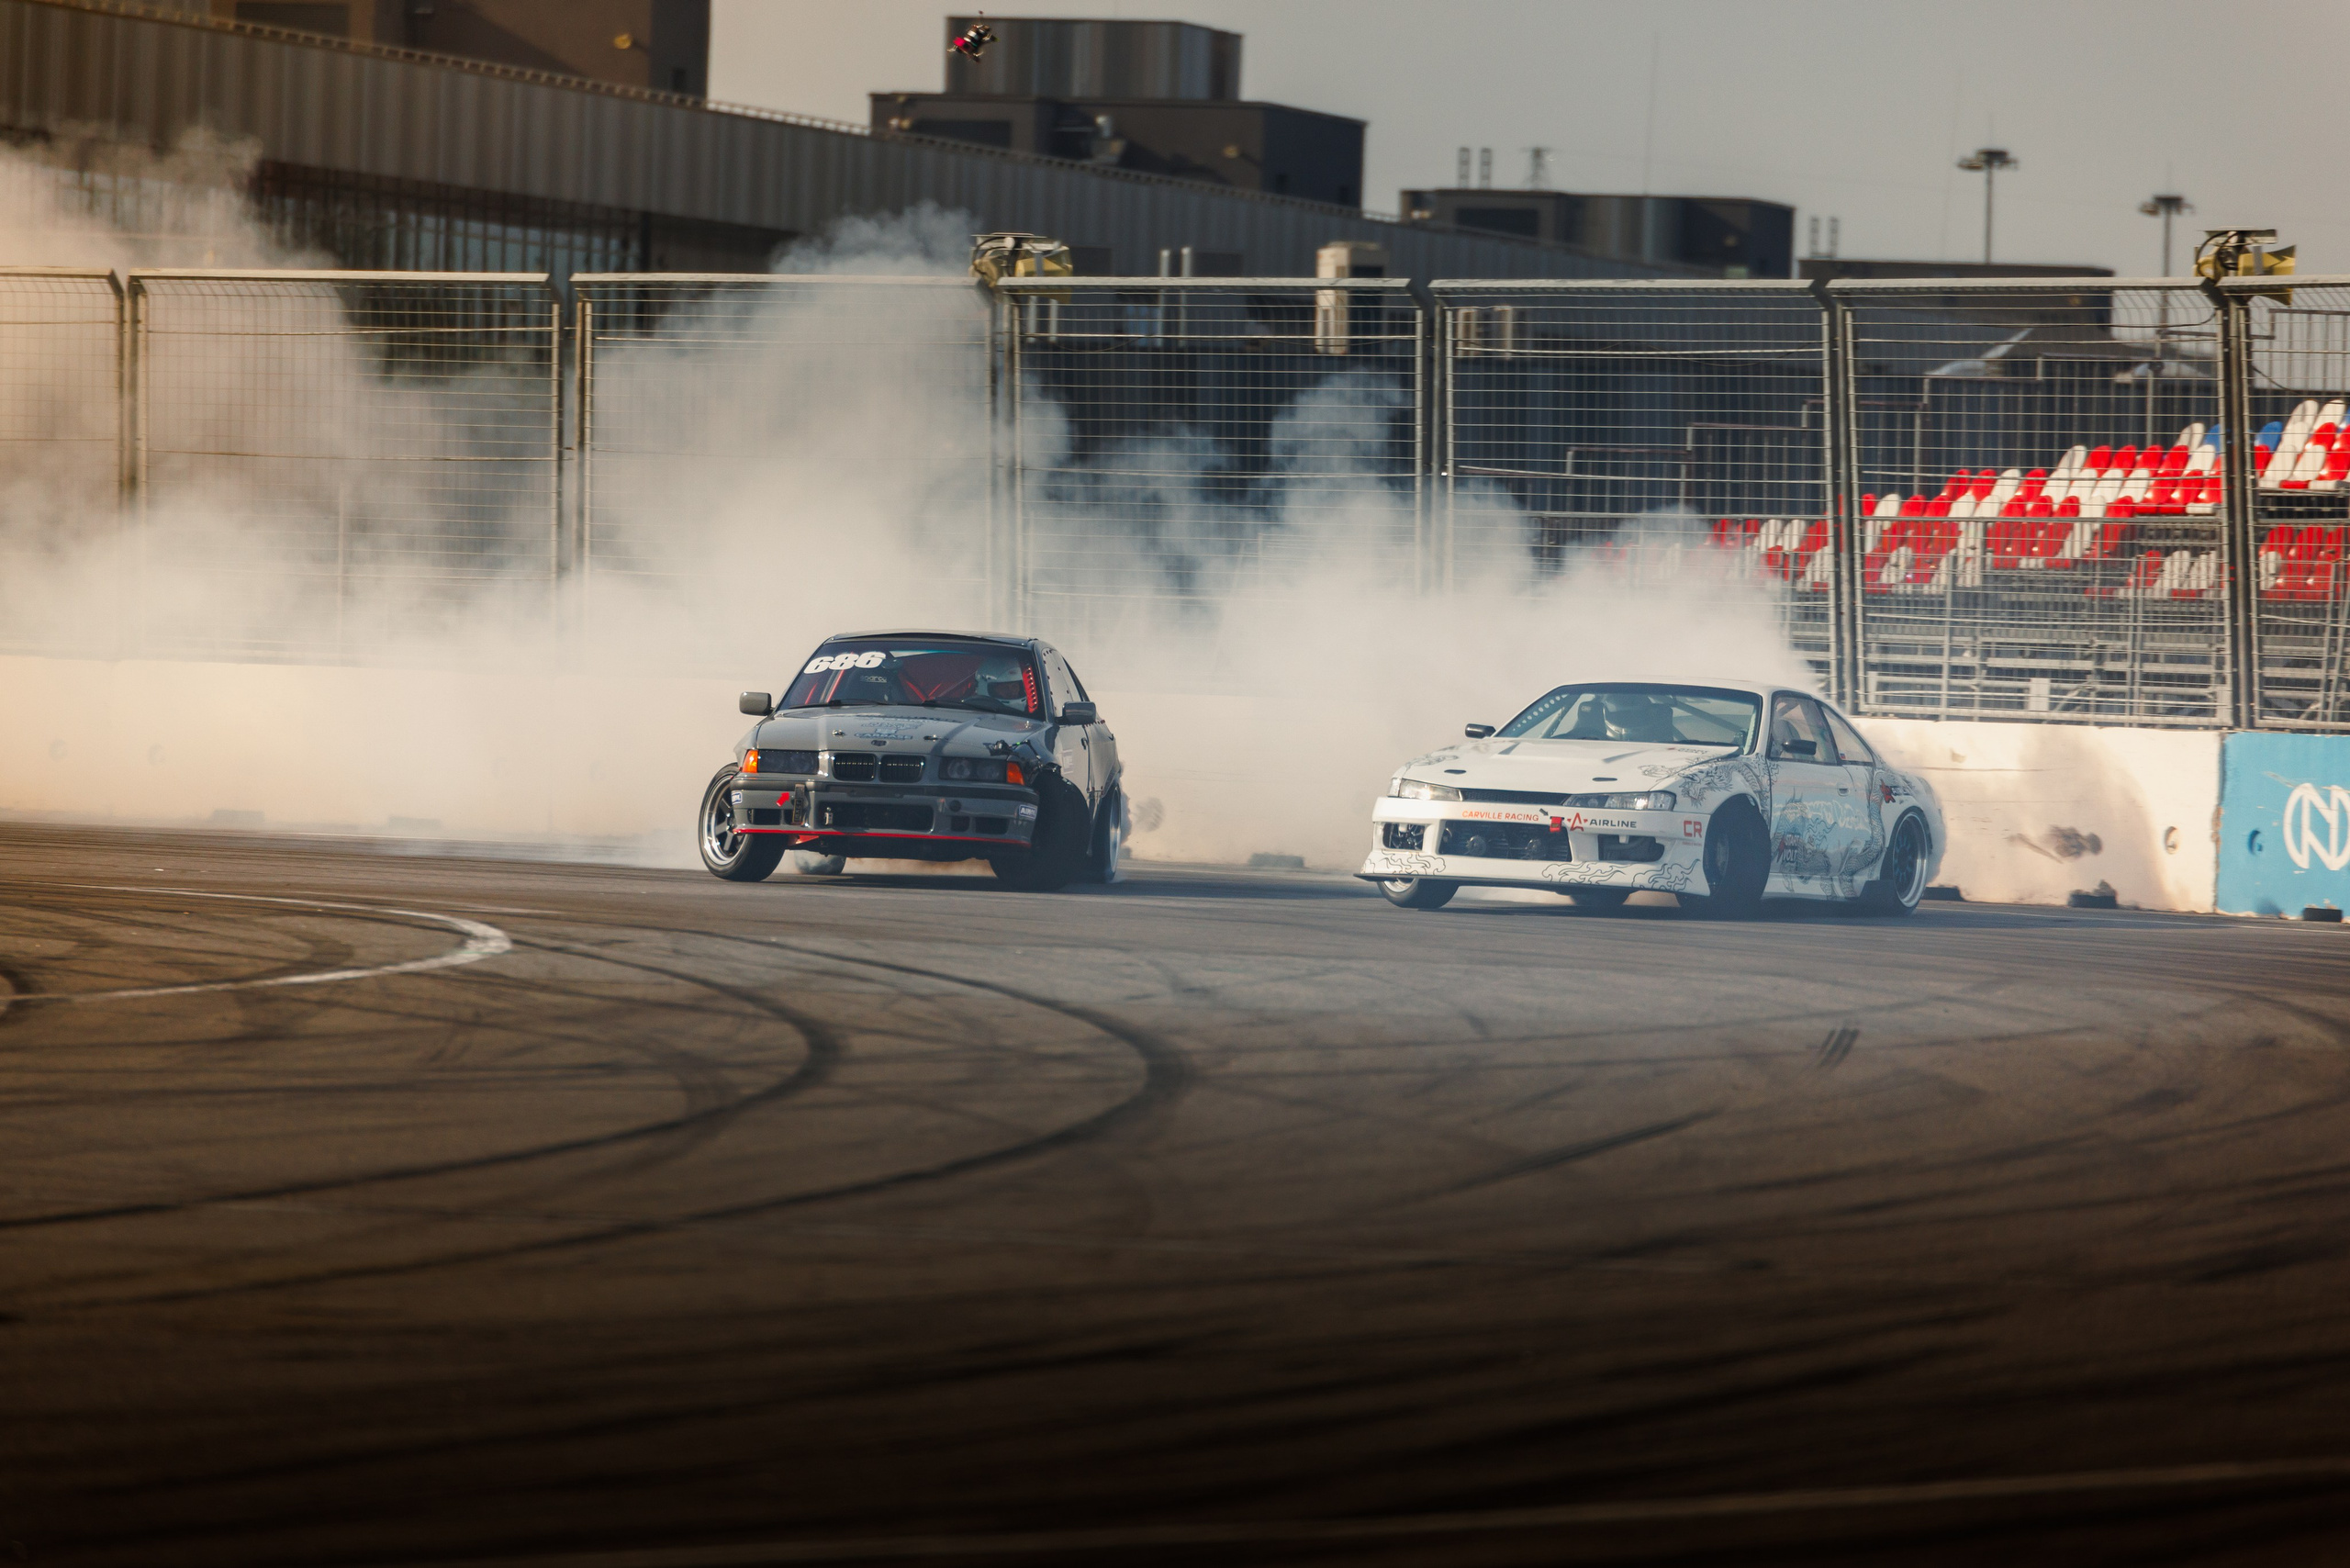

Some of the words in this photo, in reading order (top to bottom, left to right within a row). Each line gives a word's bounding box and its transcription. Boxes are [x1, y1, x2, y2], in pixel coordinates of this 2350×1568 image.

[803, 651, 887, 674] 686
[1461, 811, 1503, 820] CARVILLE
[1505, 812, 1539, 822] RACING
[1589, 819, 1637, 828] AIRLINE
[1683, 820, 1703, 838] CR
